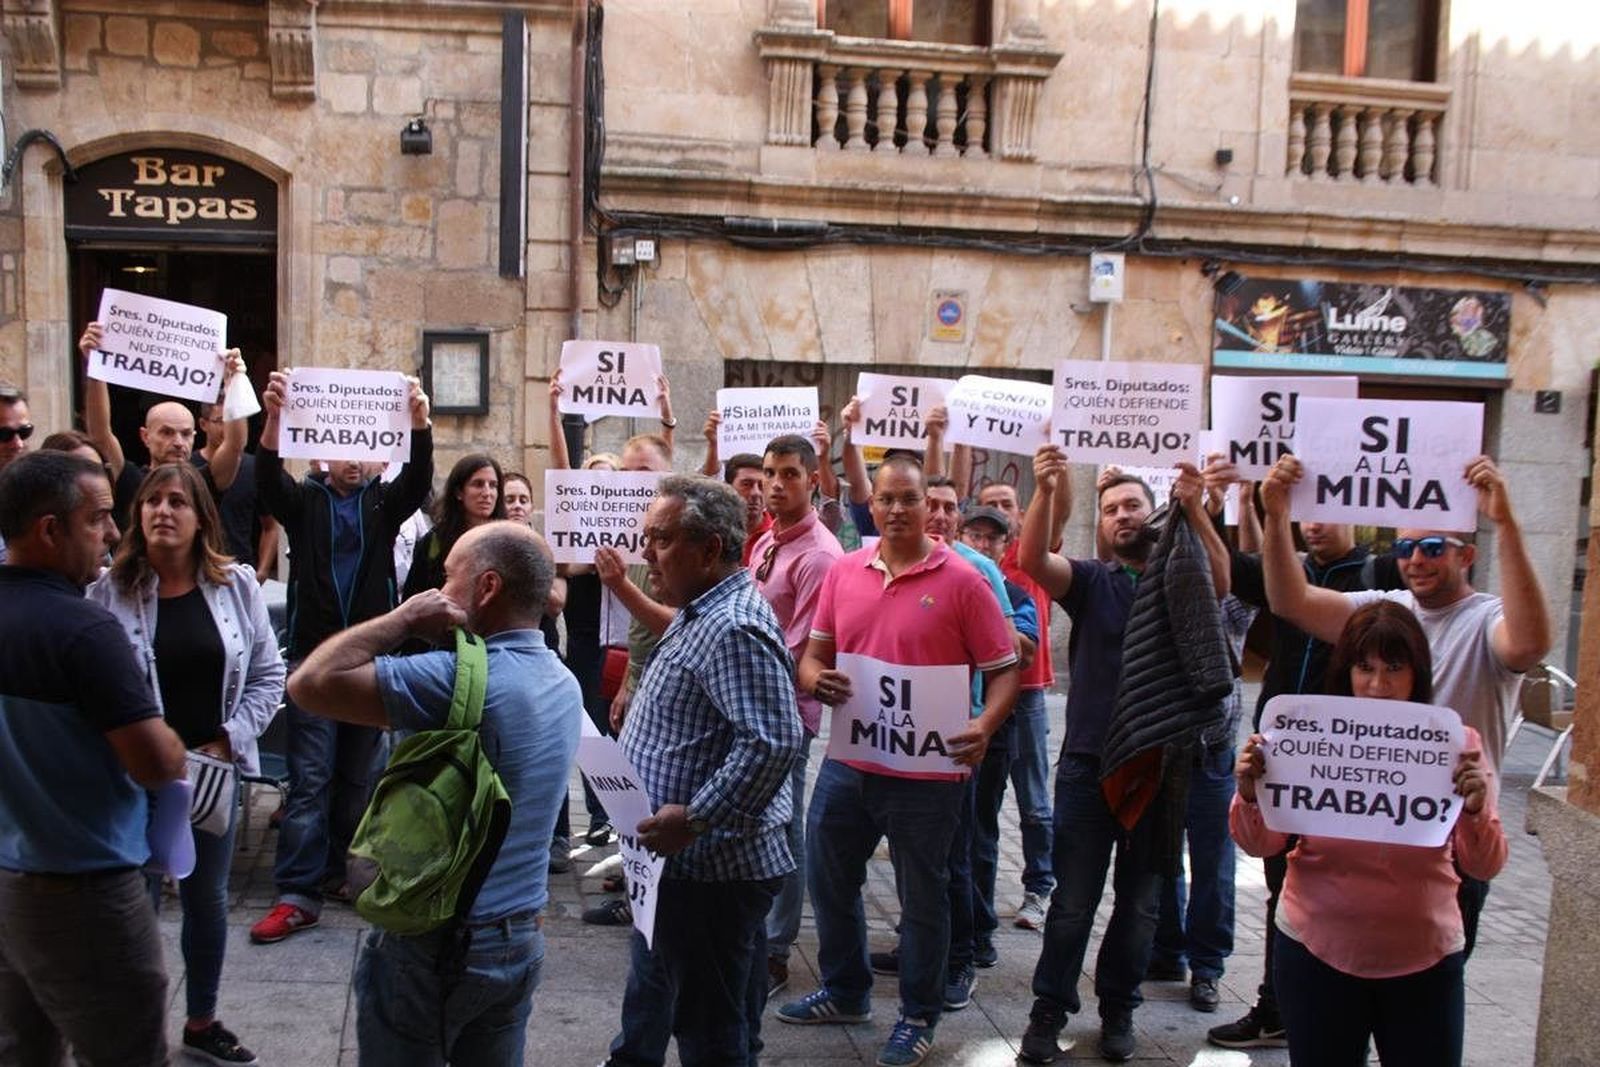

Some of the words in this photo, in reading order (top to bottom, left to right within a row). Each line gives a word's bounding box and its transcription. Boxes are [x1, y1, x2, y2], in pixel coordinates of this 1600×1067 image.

[130, 157, 225, 187] Bar
[98, 188, 258, 224] Tapas
[109, 305, 142, 321] Sres.
[147, 313, 220, 337] Diputados:
[1328, 306, 1407, 333] Lume
[128, 341, 190, 361] NUESTRO
[156, 331, 217, 352] DEFIENDE
[97, 349, 215, 387] TRABAJO?
[597, 351, 625, 373] SI
[292, 382, 324, 393] Sres.
[329, 383, 403, 397] Diputados:
[595, 375, 604, 384] A
[609, 375, 626, 385] LA
[1065, 377, 1101, 391] Sres.
[1106, 379, 1190, 395] Diputados:
[340, 400, 402, 412] DEFIENDE
[572, 385, 647, 406] MINA
[891, 385, 919, 407] SI
[1119, 397, 1189, 410] DEFIENDE
[723, 404, 811, 419] #SialaMina
[888, 408, 897, 417] A
[902, 408, 920, 419] LA
[1261, 391, 1299, 423] SI
[316, 414, 377, 426] NUESTRO
[724, 424, 733, 433] SI
[736, 423, 744, 431] A
[747, 422, 758, 431] MI
[762, 420, 811, 431] TRABAJO
[967, 413, 979, 428] Y
[985, 417, 1023, 438] TU?
[1091, 414, 1160, 426] NUESTRO
[1258, 424, 1272, 438] A
[287, 427, 404, 450] TRABAJO?
[1059, 429, 1191, 454] TRABAJO?
[1360, 416, 1410, 454] SI
[1230, 440, 1295, 466] MIN
[1355, 456, 1372, 473] A
[1381, 456, 1412, 475] LA
[555, 485, 587, 496] Sres.
[1316, 474, 1451, 512] MINA
[580, 517, 638, 528] NUESTRO
[879, 675, 912, 711] SI
[877, 709, 887, 723] A
[891, 711, 915, 728] LA
[1275, 714, 1323, 734] Sres.
[1331, 718, 1450, 743] Diputados:
[851, 718, 948, 757] MINA
[1272, 739, 1344, 758] ¿QUIÉN
[1349, 745, 1449, 767] DEFIENDE
[1310, 764, 1407, 786] NUESTRO
[1265, 783, 1451, 827] TRABAJO?
